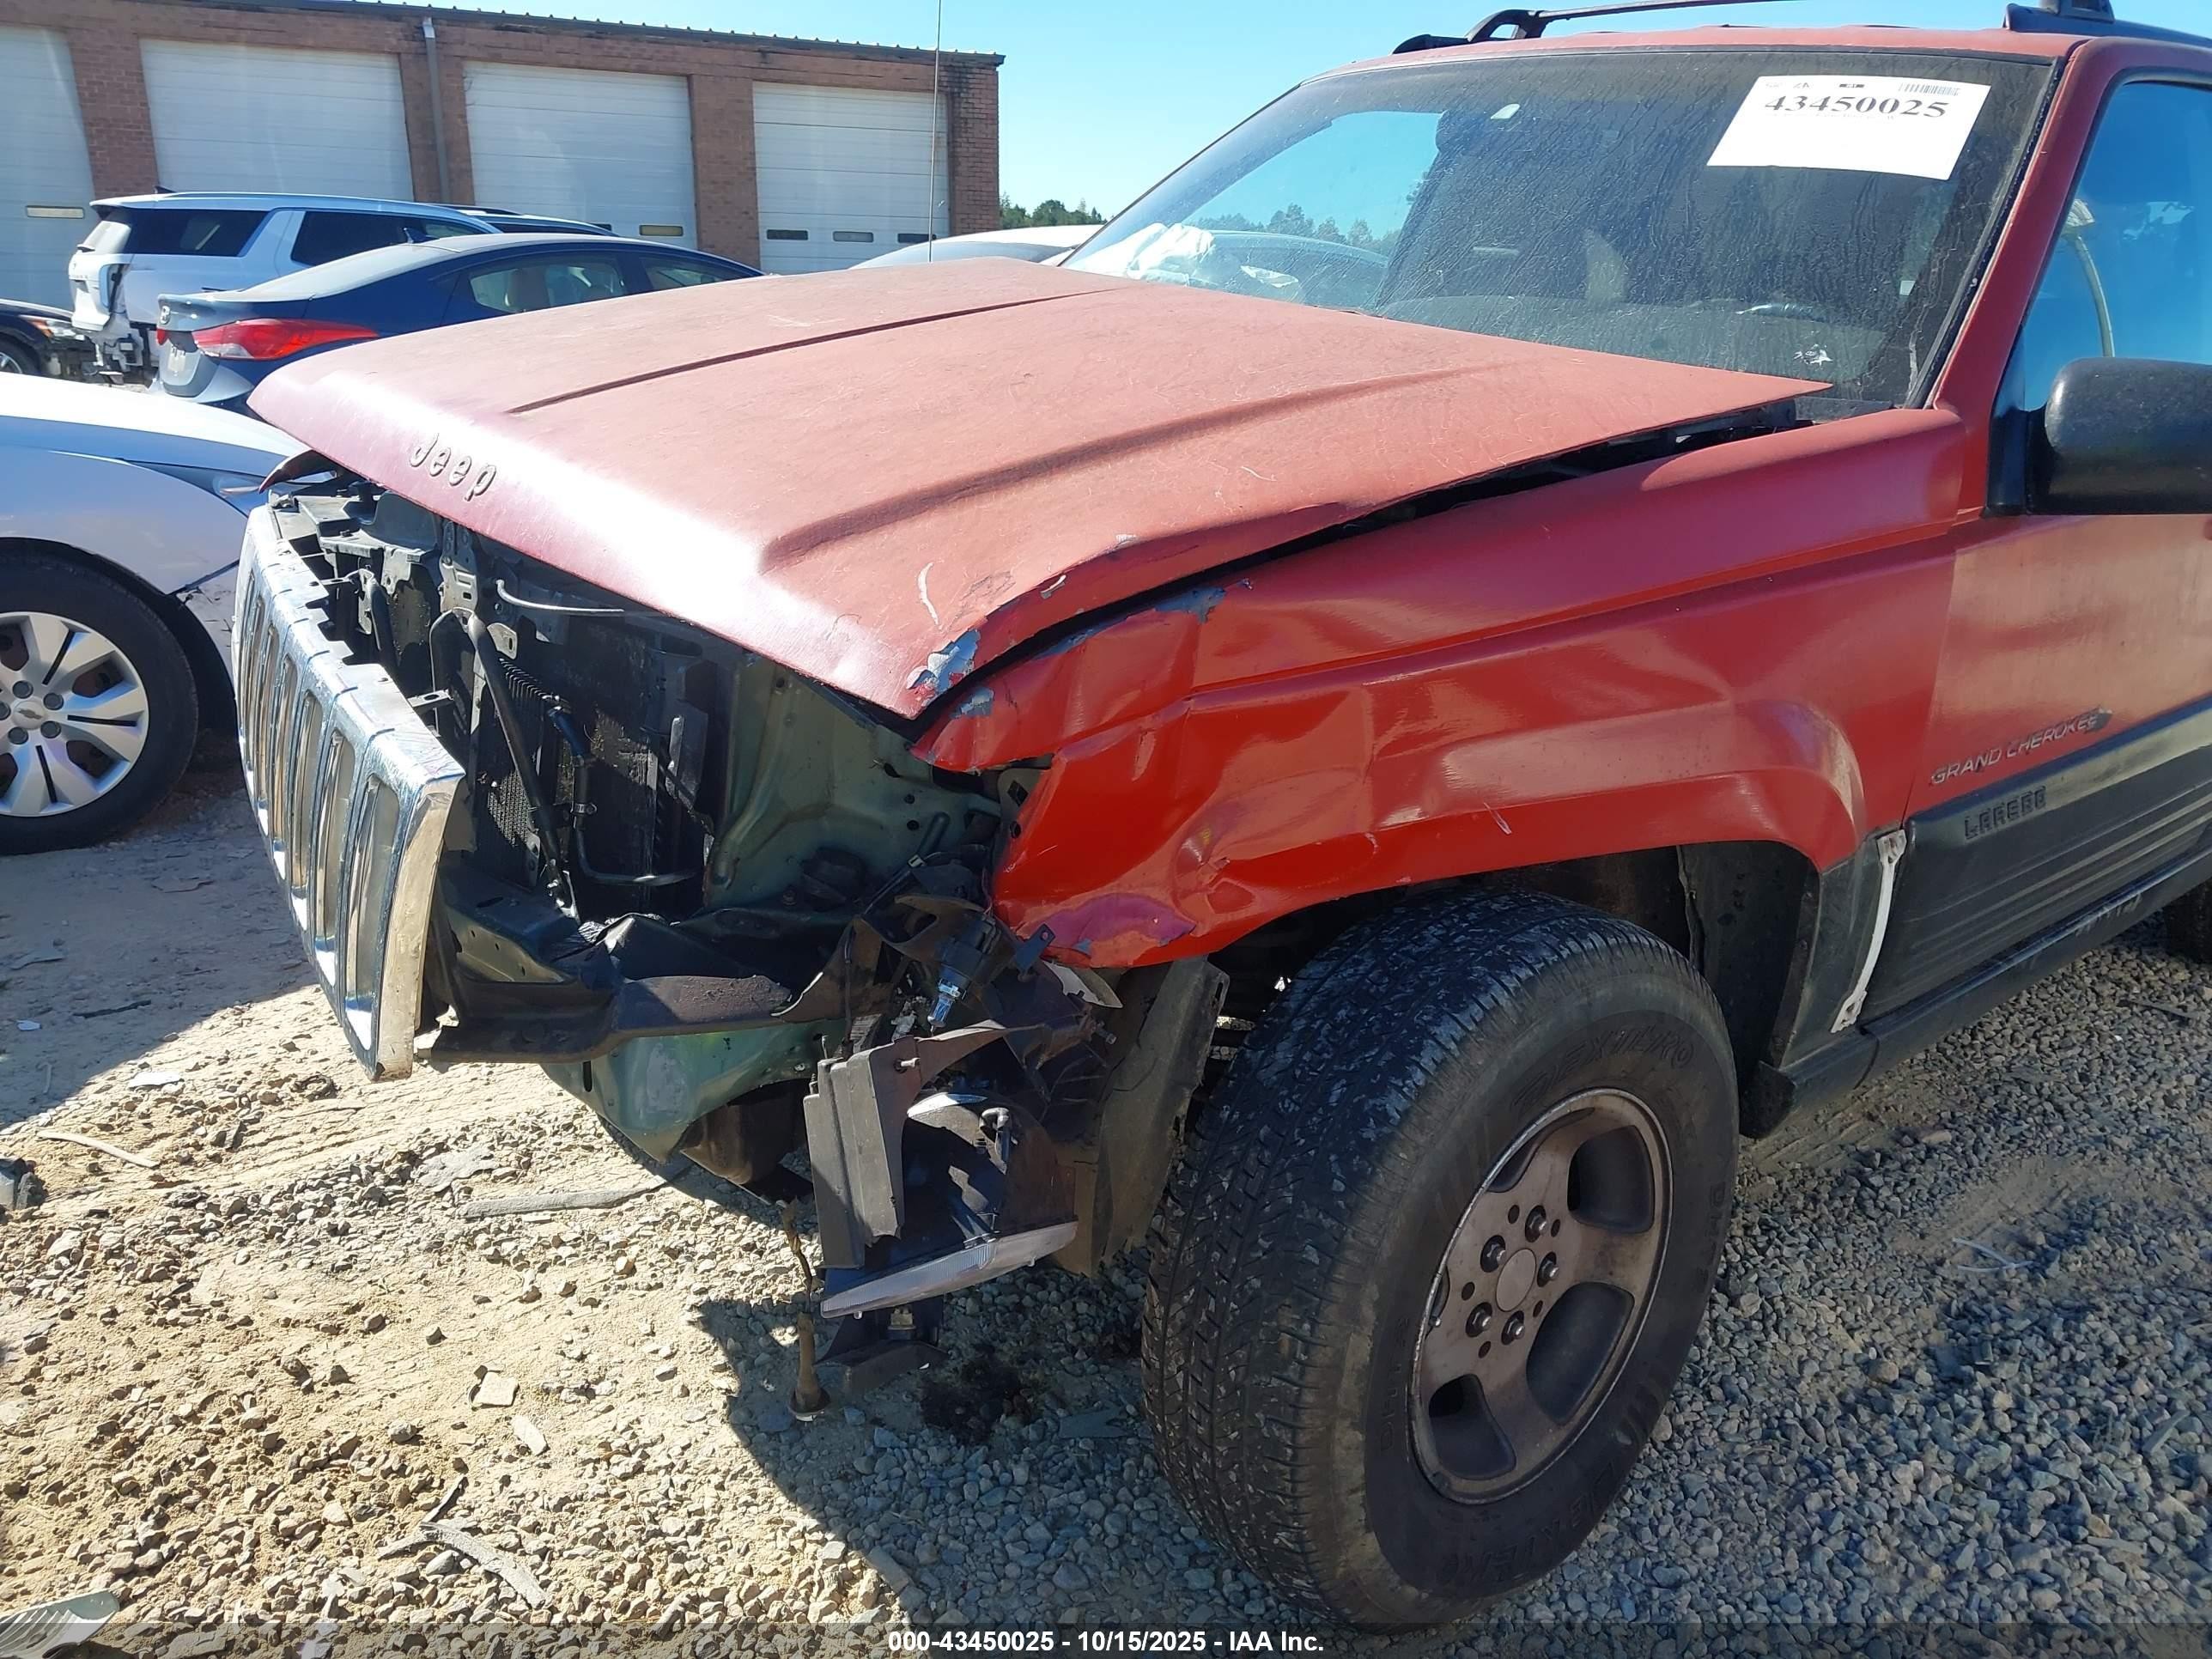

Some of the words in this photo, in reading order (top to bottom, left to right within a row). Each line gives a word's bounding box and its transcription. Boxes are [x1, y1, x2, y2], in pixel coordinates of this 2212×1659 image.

[1765, 94, 1949, 118] 43450025
[409, 432, 497, 502] Jeep
[1929, 748, 2002, 785] GRAND
[2006, 712, 2099, 758] CHEROKEE
